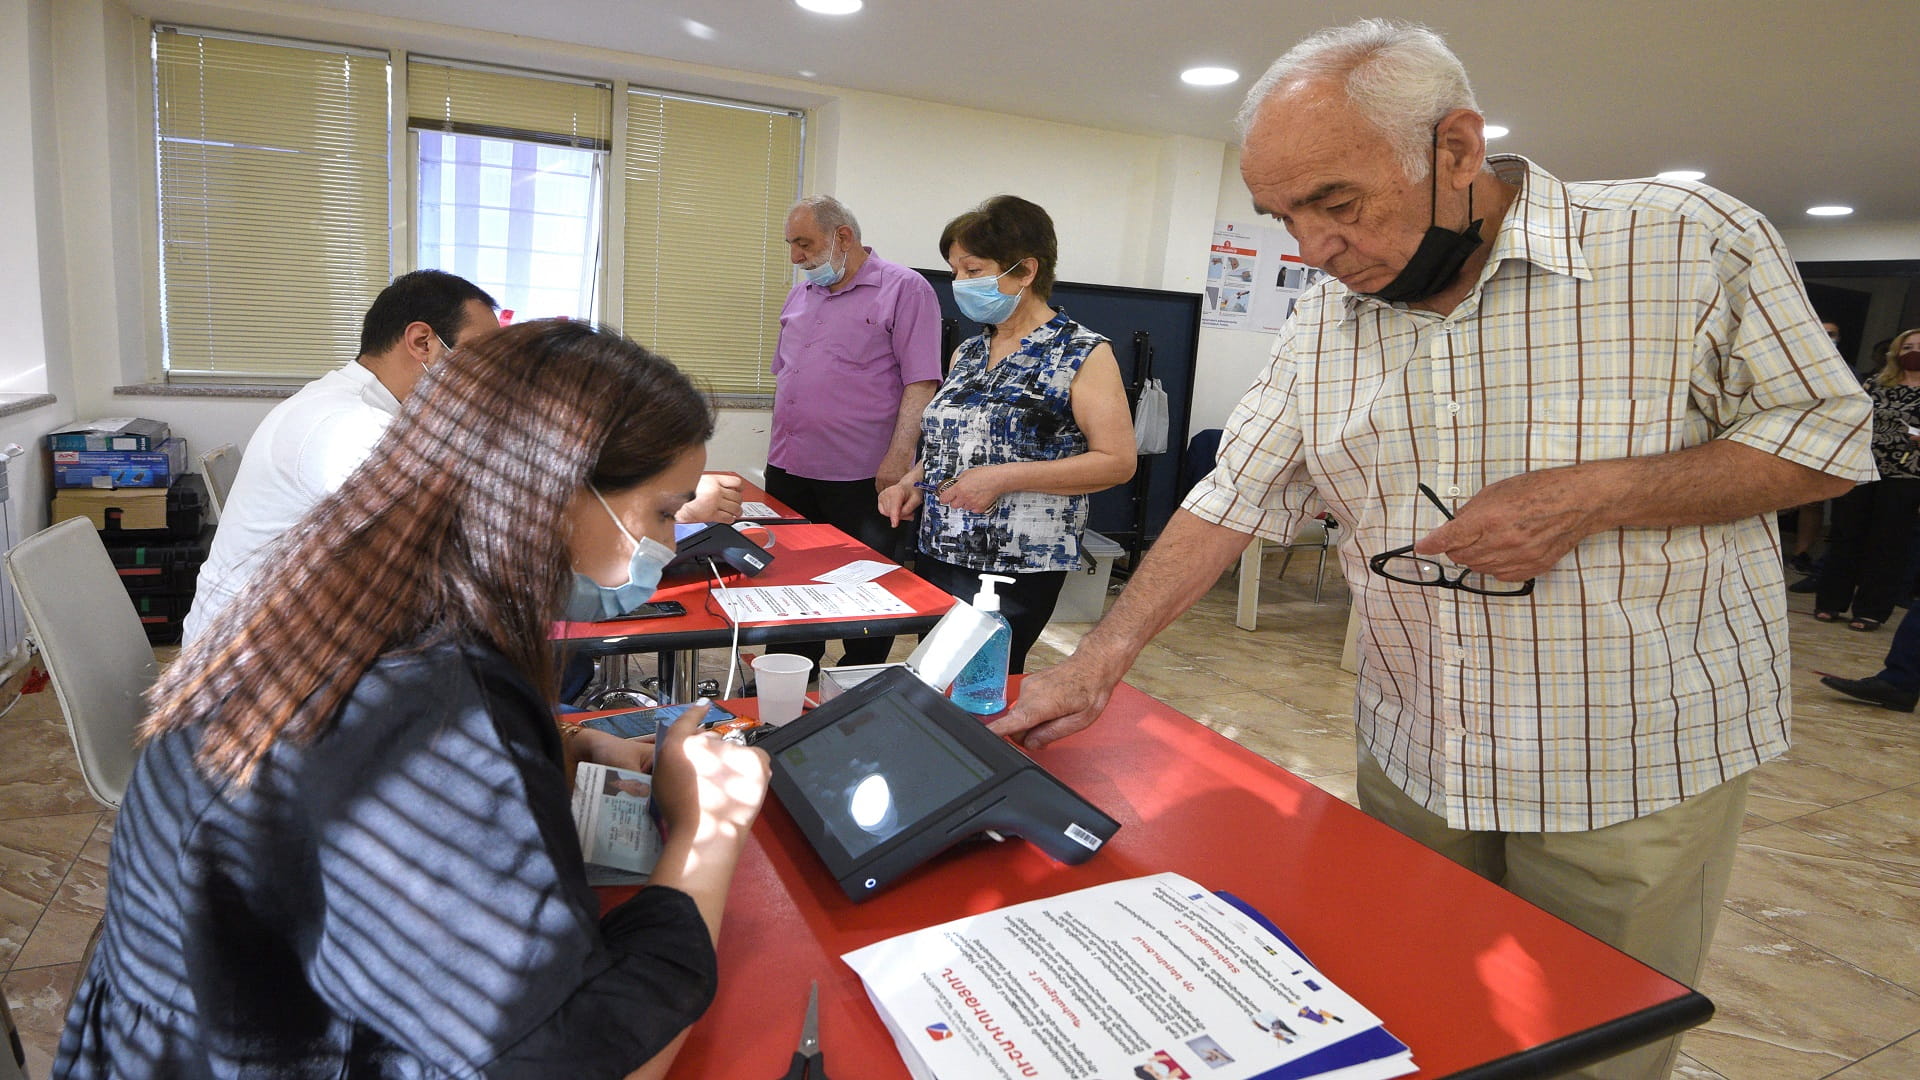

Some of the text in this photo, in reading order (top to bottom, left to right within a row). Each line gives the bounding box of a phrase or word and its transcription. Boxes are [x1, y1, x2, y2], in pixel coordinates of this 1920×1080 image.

[1179, 924, 1240, 974] Տեղեկացնում
[942, 968, 1037, 1077] ՈՒՇԱԴՐՈՒԹՅՈՒՆ
[1032, 976, 1081, 1028] Պահանջում
